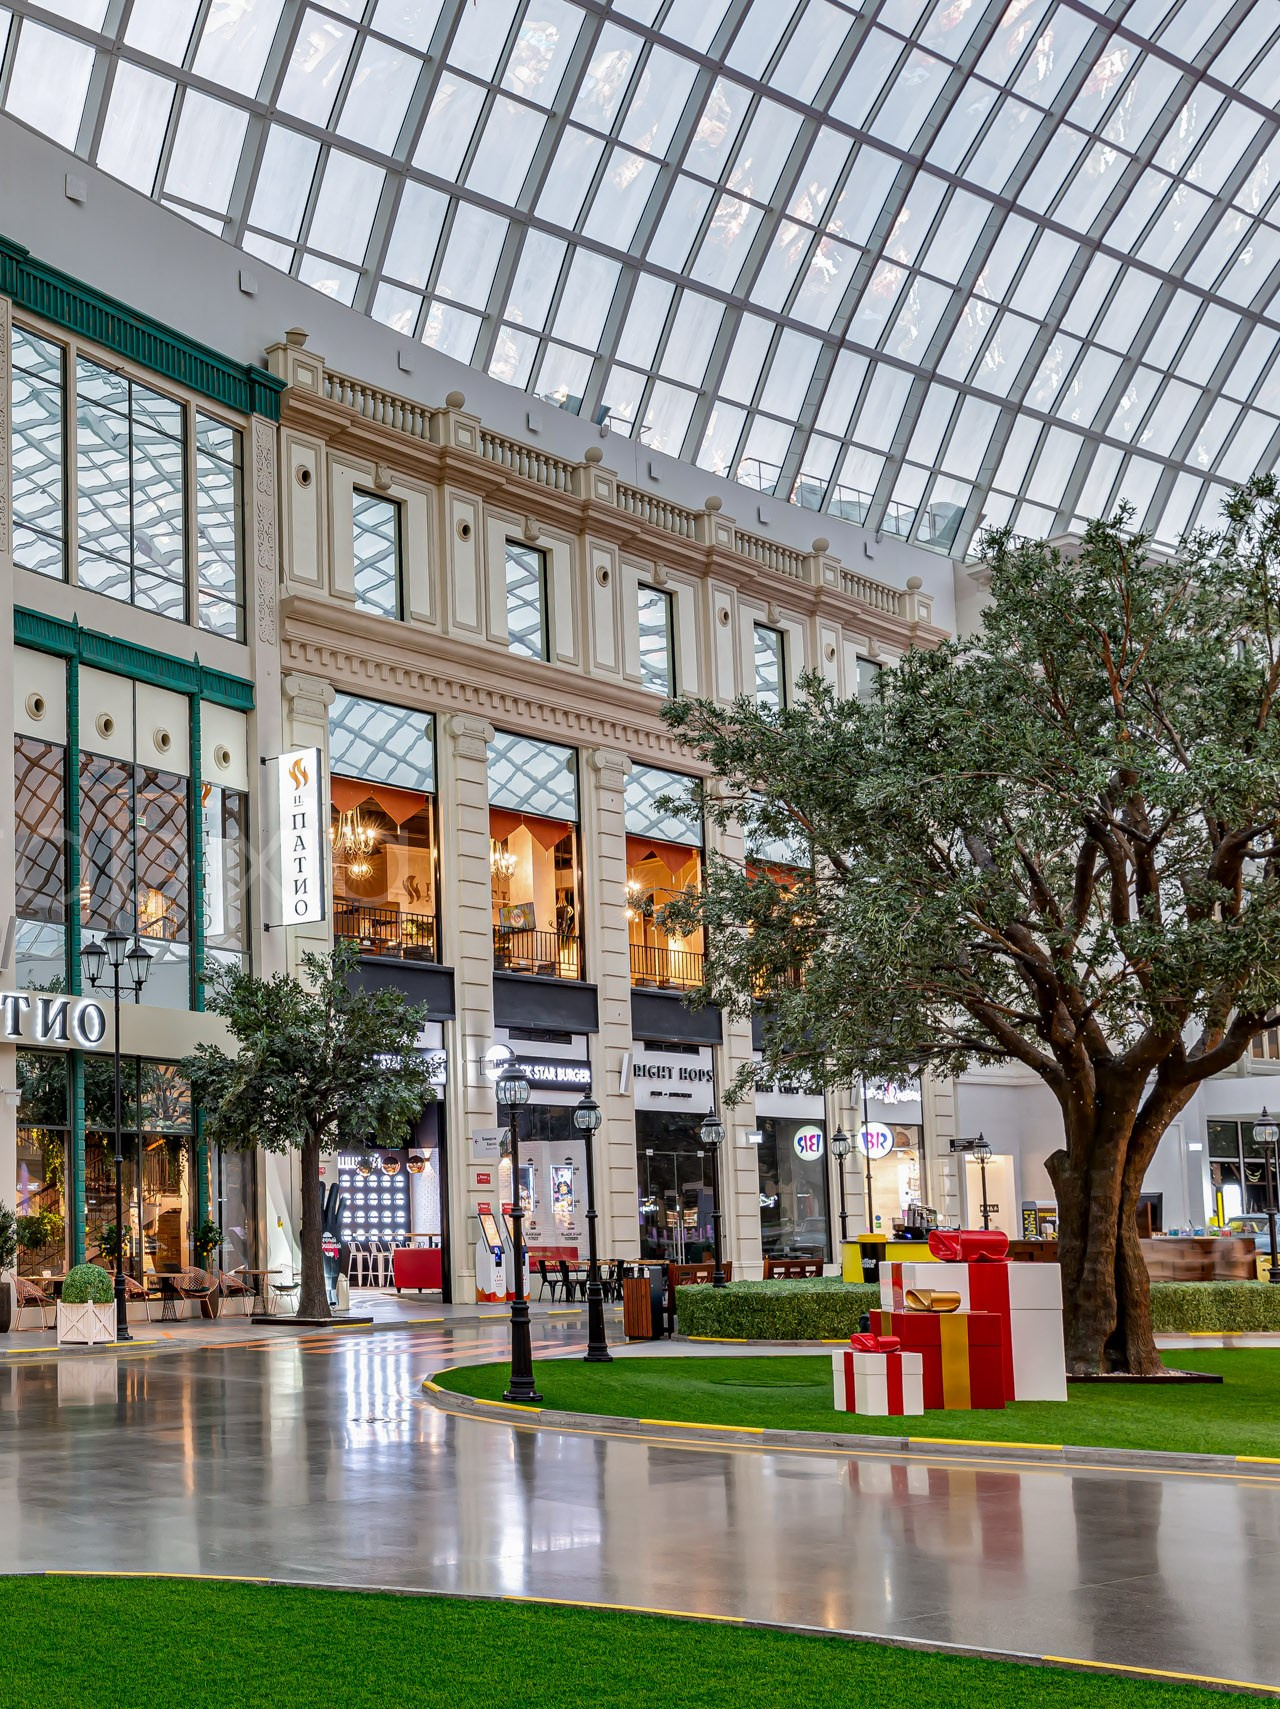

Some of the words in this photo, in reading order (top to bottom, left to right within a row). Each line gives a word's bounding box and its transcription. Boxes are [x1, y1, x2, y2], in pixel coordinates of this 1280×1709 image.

[292, 812, 308, 916] ПАТИО
[533, 1065, 556, 1080] STAR
[556, 1067, 591, 1083] BURGER
